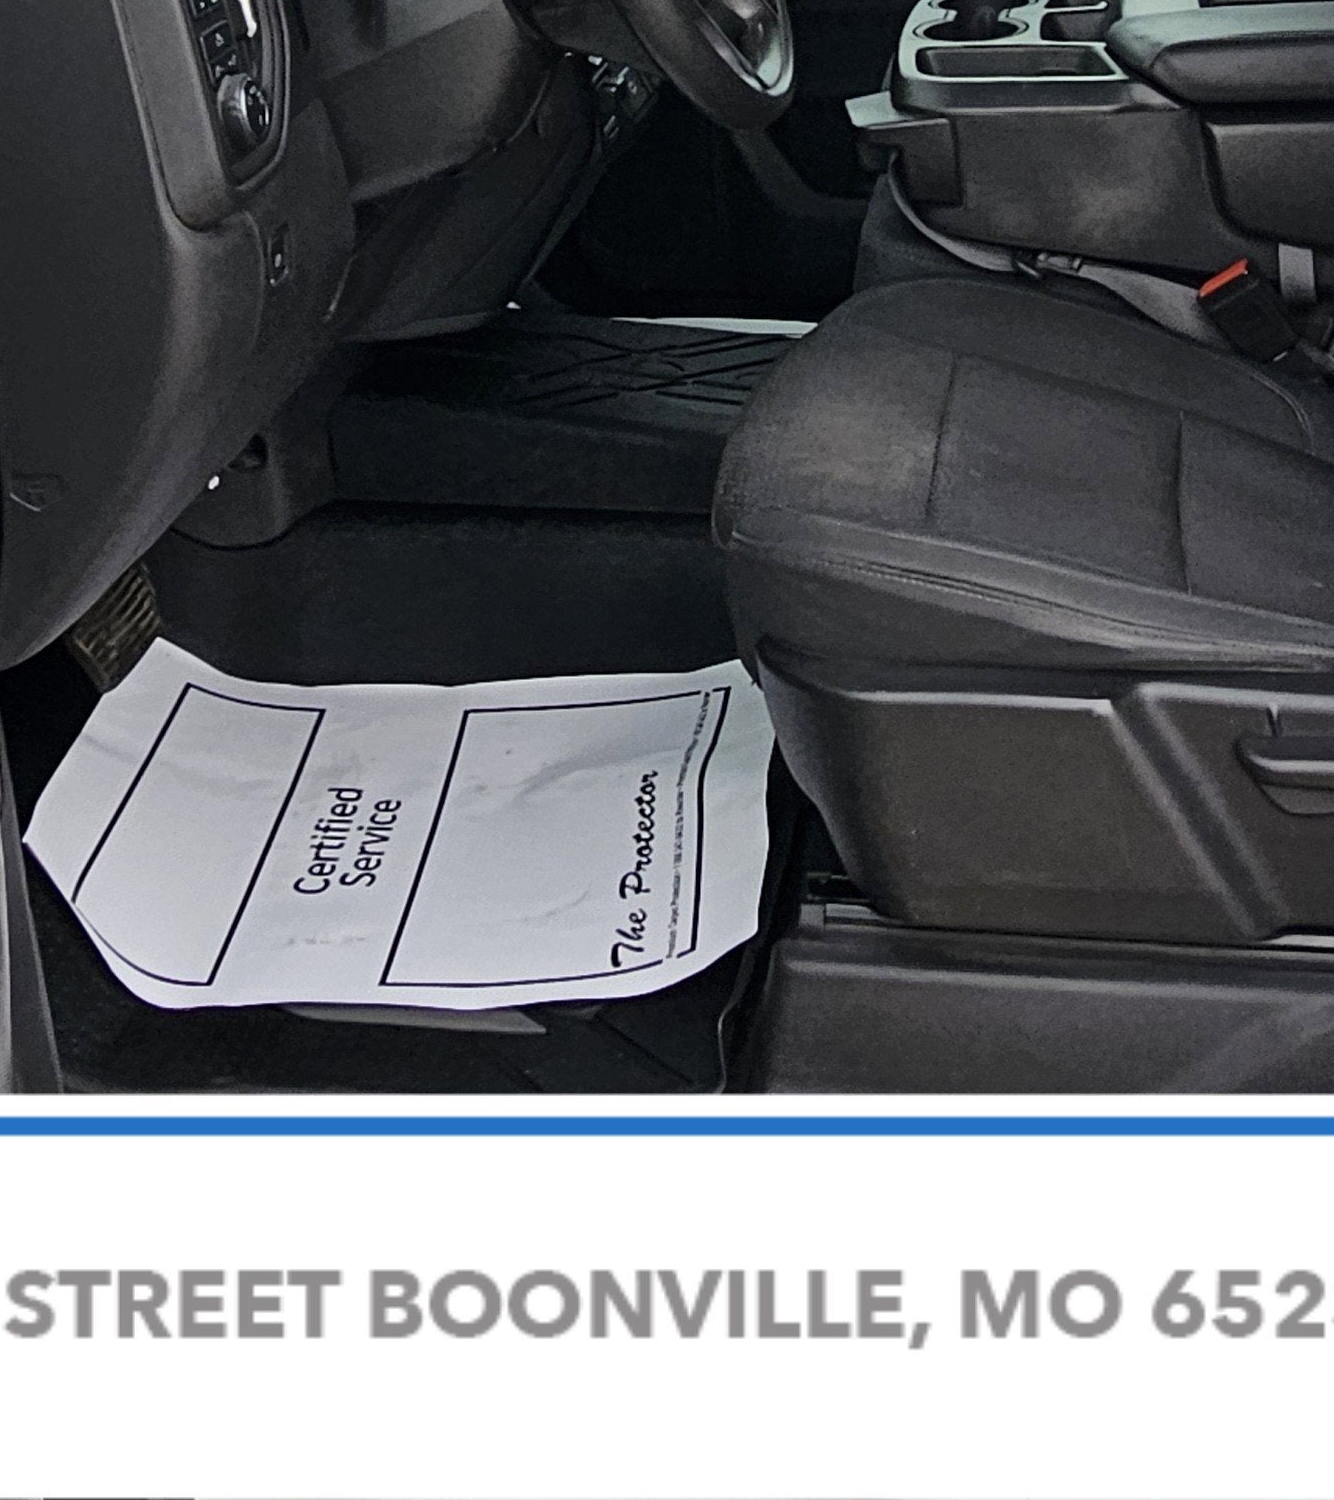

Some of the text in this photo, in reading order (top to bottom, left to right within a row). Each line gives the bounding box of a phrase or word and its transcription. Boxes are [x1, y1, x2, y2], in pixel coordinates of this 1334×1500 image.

[294, 785, 364, 896] Certified
[339, 796, 402, 889] Service
[610, 769, 660, 968] The Protector
